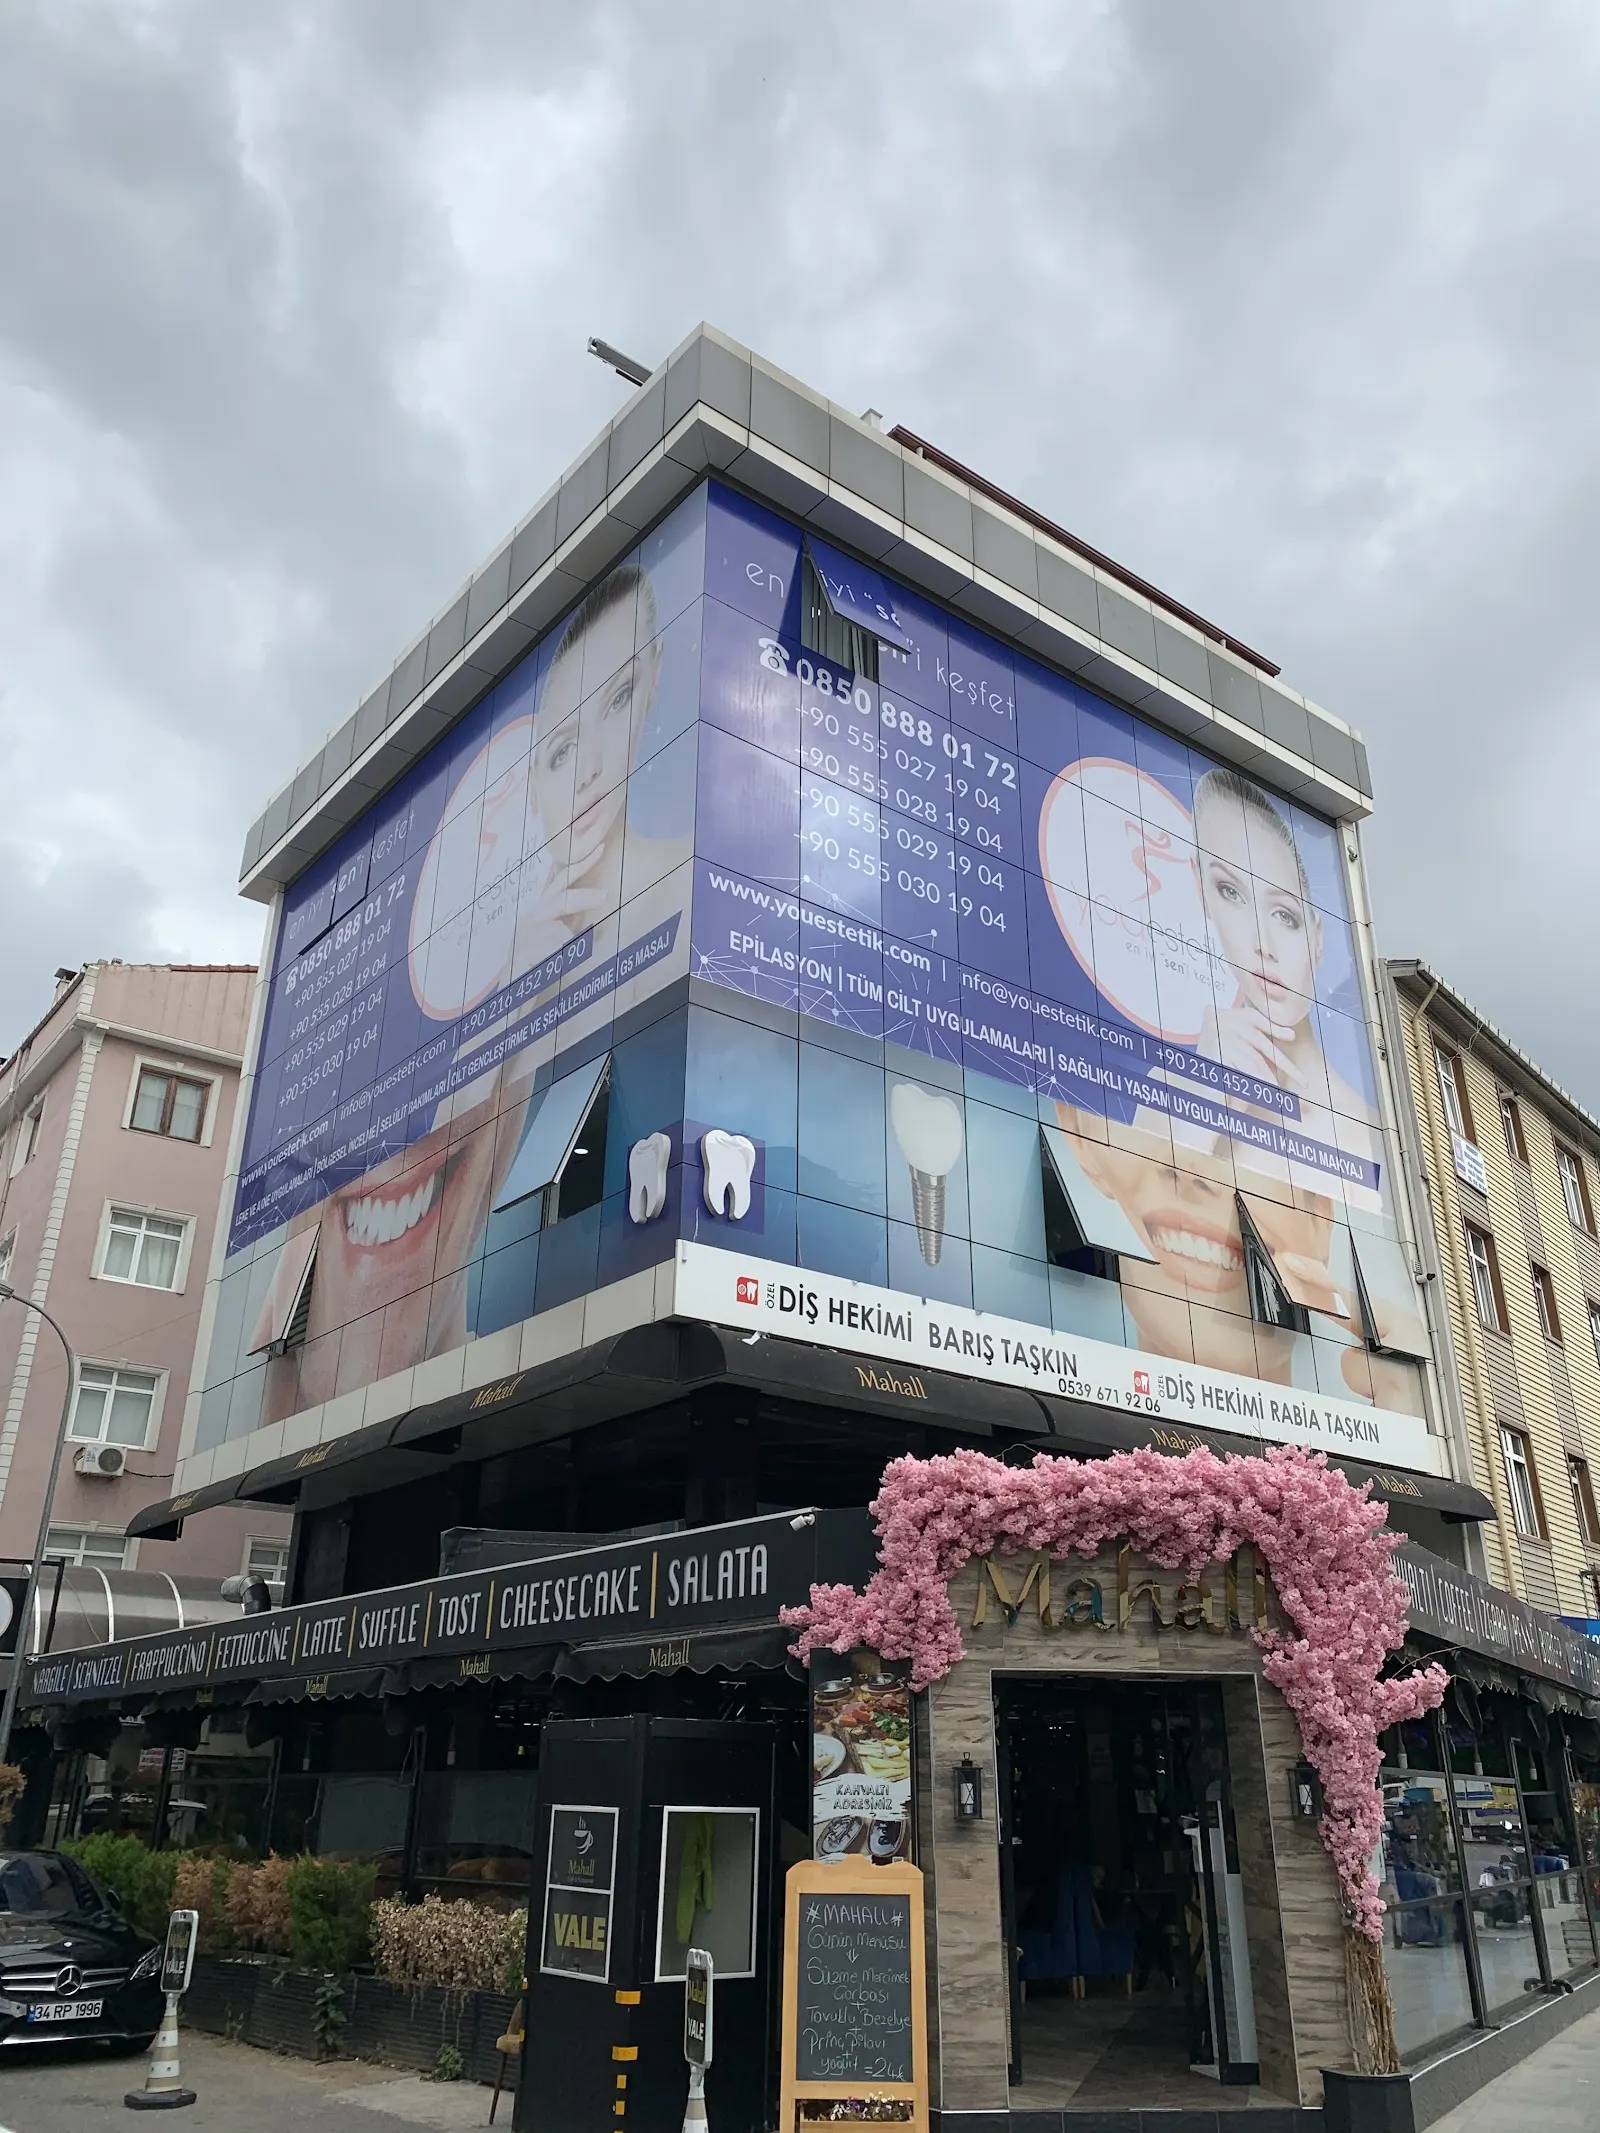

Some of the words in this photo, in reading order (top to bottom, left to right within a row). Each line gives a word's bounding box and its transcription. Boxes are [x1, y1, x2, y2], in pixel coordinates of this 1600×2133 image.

[745, 561, 785, 599] en
[935, 656, 1016, 721] keşfet
[794, 703, 841, 736] +90
[847, 726, 889, 761] 555
[895, 749, 937, 783] 027
[943, 772, 969, 799] 19
[975, 787, 1002, 815] 04
[795, 658, 872, 715] 0850
[881, 701, 934, 747] 888
[942, 733, 976, 769] 01
[983, 751, 1018, 790] 72
[794, 744, 841, 777] +90
[847, 766, 889, 801] 555
[895, 788, 938, 823] 028
[944, 811, 970, 838] 19
[976, 826, 1004, 854] 04
[793, 786, 841, 817] +90
[847, 806, 890, 841] 555
[896, 828, 939, 861] 029
[946, 850, 972, 877] 19
[977, 864, 1005, 892] 04
[793, 829, 841, 861] +90
[847, 849, 891, 884] 555
[897, 870, 941, 905] 030
[948, 891, 973, 918] 19
[979, 906, 1007, 934] 04
[293, 985, 314, 1010] +90
[315, 968, 335, 994] 555
[336, 947, 358, 977] 027
[359, 931, 375, 958] 19
[376, 918, 392, 943] 04
[299, 937, 332, 982] 0850
[334, 913, 362, 950] 888
[364, 894, 382, 925] 01
[387, 874, 406, 907] 72
[289, 1018, 310, 1042] +90
[310, 999, 331, 1027] 555
[331, 979, 353, 1008] 028
[355, 965, 370, 992] 19
[371, 952, 387, 977] 04
[461, 1008, 487, 1035] +90
[488, 988, 512, 1021] 216
[515, 969, 542, 1000] 452
[545, 954, 563, 981] 90
[567, 936, 586, 965] 90
[529, 1016, 542, 1036] VE
[542, 967, 615, 1031] ŞEKİLLENDİRME
[620, 958, 634, 977] G5
[634, 930, 670, 967] MASAJ
[708, 871, 931, 973] www.youestetik.com
[1156, 1046, 1187, 1071] +90
[1189, 1057, 1219, 1083] 216
[1222, 1072, 1251, 1097] 452
[1253, 1083, 1273, 1105] 90
[1275, 1091, 1294, 1113] 90
[279, 1085, 299, 1109] +90
[299, 1066, 321, 1095] 555
[321, 1048, 344, 1078] 030
[345, 1036, 361, 1062] 19
[362, 1023, 378, 1049] 04
[284, 1050, 305, 1074] +90
[304, 1035, 326, 1060] 555
[327, 1014, 349, 1043] 029
[350, 1000, 366, 1027] 19
[366, 987, 383, 1012] 04
[730, 930, 833, 985] EPİLASYON
[846, 972, 883, 1003] TÜM
[887, 985, 922, 1018] CİLT
[926, 1003, 1047, 1065] UYGULAMALARI
[1057, 1054, 1123, 1093] SAĞLIKLI
[1173, 1095, 1271, 1147] UYGULAMALARI
[1318, 1148, 1365, 1181] MAKYAJ
[765, 1281, 776, 1310] ÖZEL
[778, 1283, 819, 1325] DİŞ
[828, 1296, 913, 1343] HEKİMİ
[928, 1321, 995, 1367] BARIŞ
[1000, 1337, 1079, 1379] TAŞKIN
[468, 1374, 527, 1411] Mahall
[854, 1365, 928, 1400] Mahall
[1058, 1377, 1092, 1400] 0539
[1096, 1384, 1121, 1407] 671
[1124, 1391, 1142, 1410] 92
[1144, 1395, 1162, 1414] 06
[1156, 1374, 1166, 1399] ÖZEL
[1166, 1372, 1196, 1409] DİŞ
[1200, 1384, 1265, 1420] HEKİMİ
[1270, 1401, 1321, 1432] RABİA
[1324, 1410, 1380, 1445] TAŞKIN
[293, 1441, 336, 1470] Mahall
[1149, 1427, 1205, 1453] Mahall
[1374, 1473, 1423, 1499] Mahall
[30, 1660, 69, 1695] NARGİLE
[73, 1652, 123, 1690] SCHNİTZEL
[130, 1636, 206, 1682] FRAPPUCCİNO
[214, 1621, 292, 1670] FETTUCCİNE
[301, 1616, 346, 1658] LATTE
[359, 1603, 420, 1649] SUFFLE
[437, 1592, 482, 1638] TOST
[499, 1565, 643, 1630] CHEESECAKE
[667, 1543, 768, 1607] SALATA
[971, 1537, 1269, 1635] Mahall
[1438, 1577, 1475, 1634] COFFEE
[459, 1653, 492, 1677] Mahall
[649, 1639, 691, 1668] Mahall
[833, 1797, 893, 1810] ADRESİNİZ
[835, 1784, 890, 1796] KAHVALTI
[568, 1858, 596, 1877] Mahall
[166, 1960, 186, 1975] VALE
[553, 1913, 607, 1951] VALE
[35, 2005, 50, 2020] 34
[53, 2004, 73, 2019] RP
[75, 2002, 101, 2017] 1996
[687, 2017, 705, 2042] VALE
